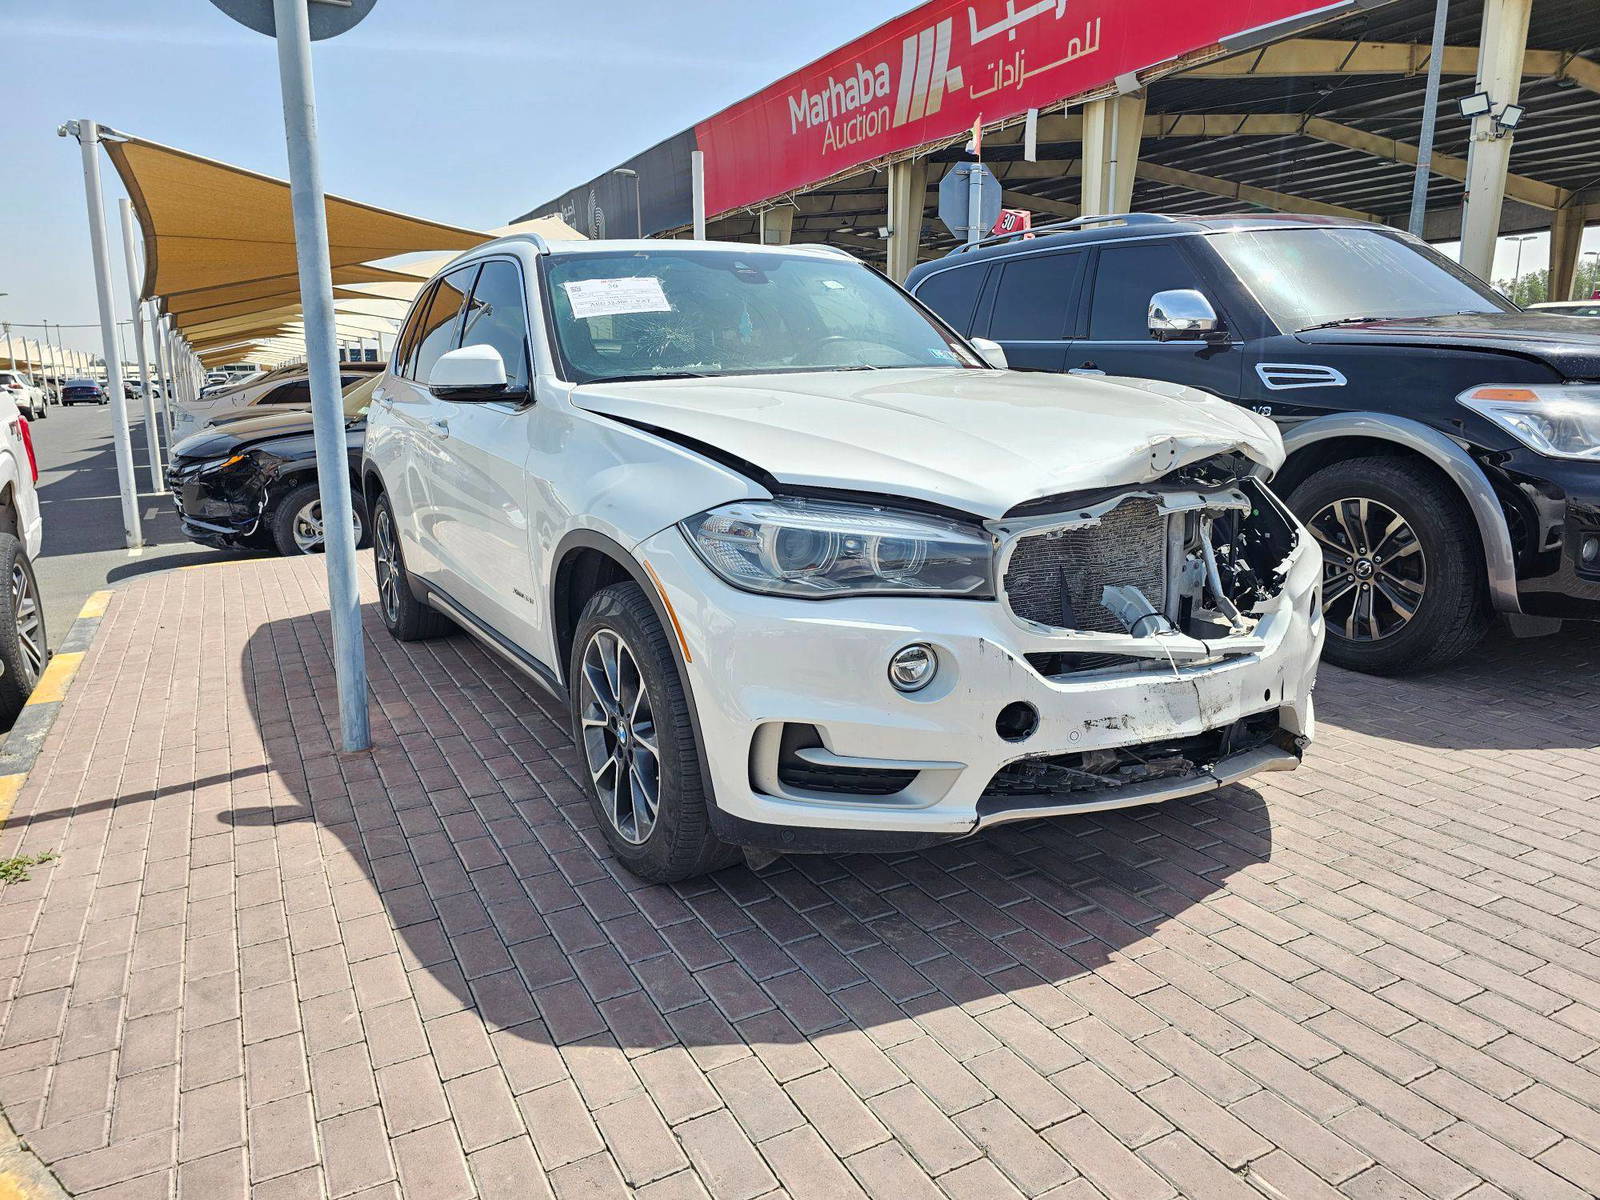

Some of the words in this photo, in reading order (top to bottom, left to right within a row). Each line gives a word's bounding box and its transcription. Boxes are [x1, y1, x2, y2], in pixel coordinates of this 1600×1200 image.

[970, 17, 1101, 100] للمزادات
[788, 62, 890, 135] Marhaba
[822, 106, 889, 155] Auction
[1001, 213, 1016, 231] 30
[1252, 405, 1272, 417] V8
